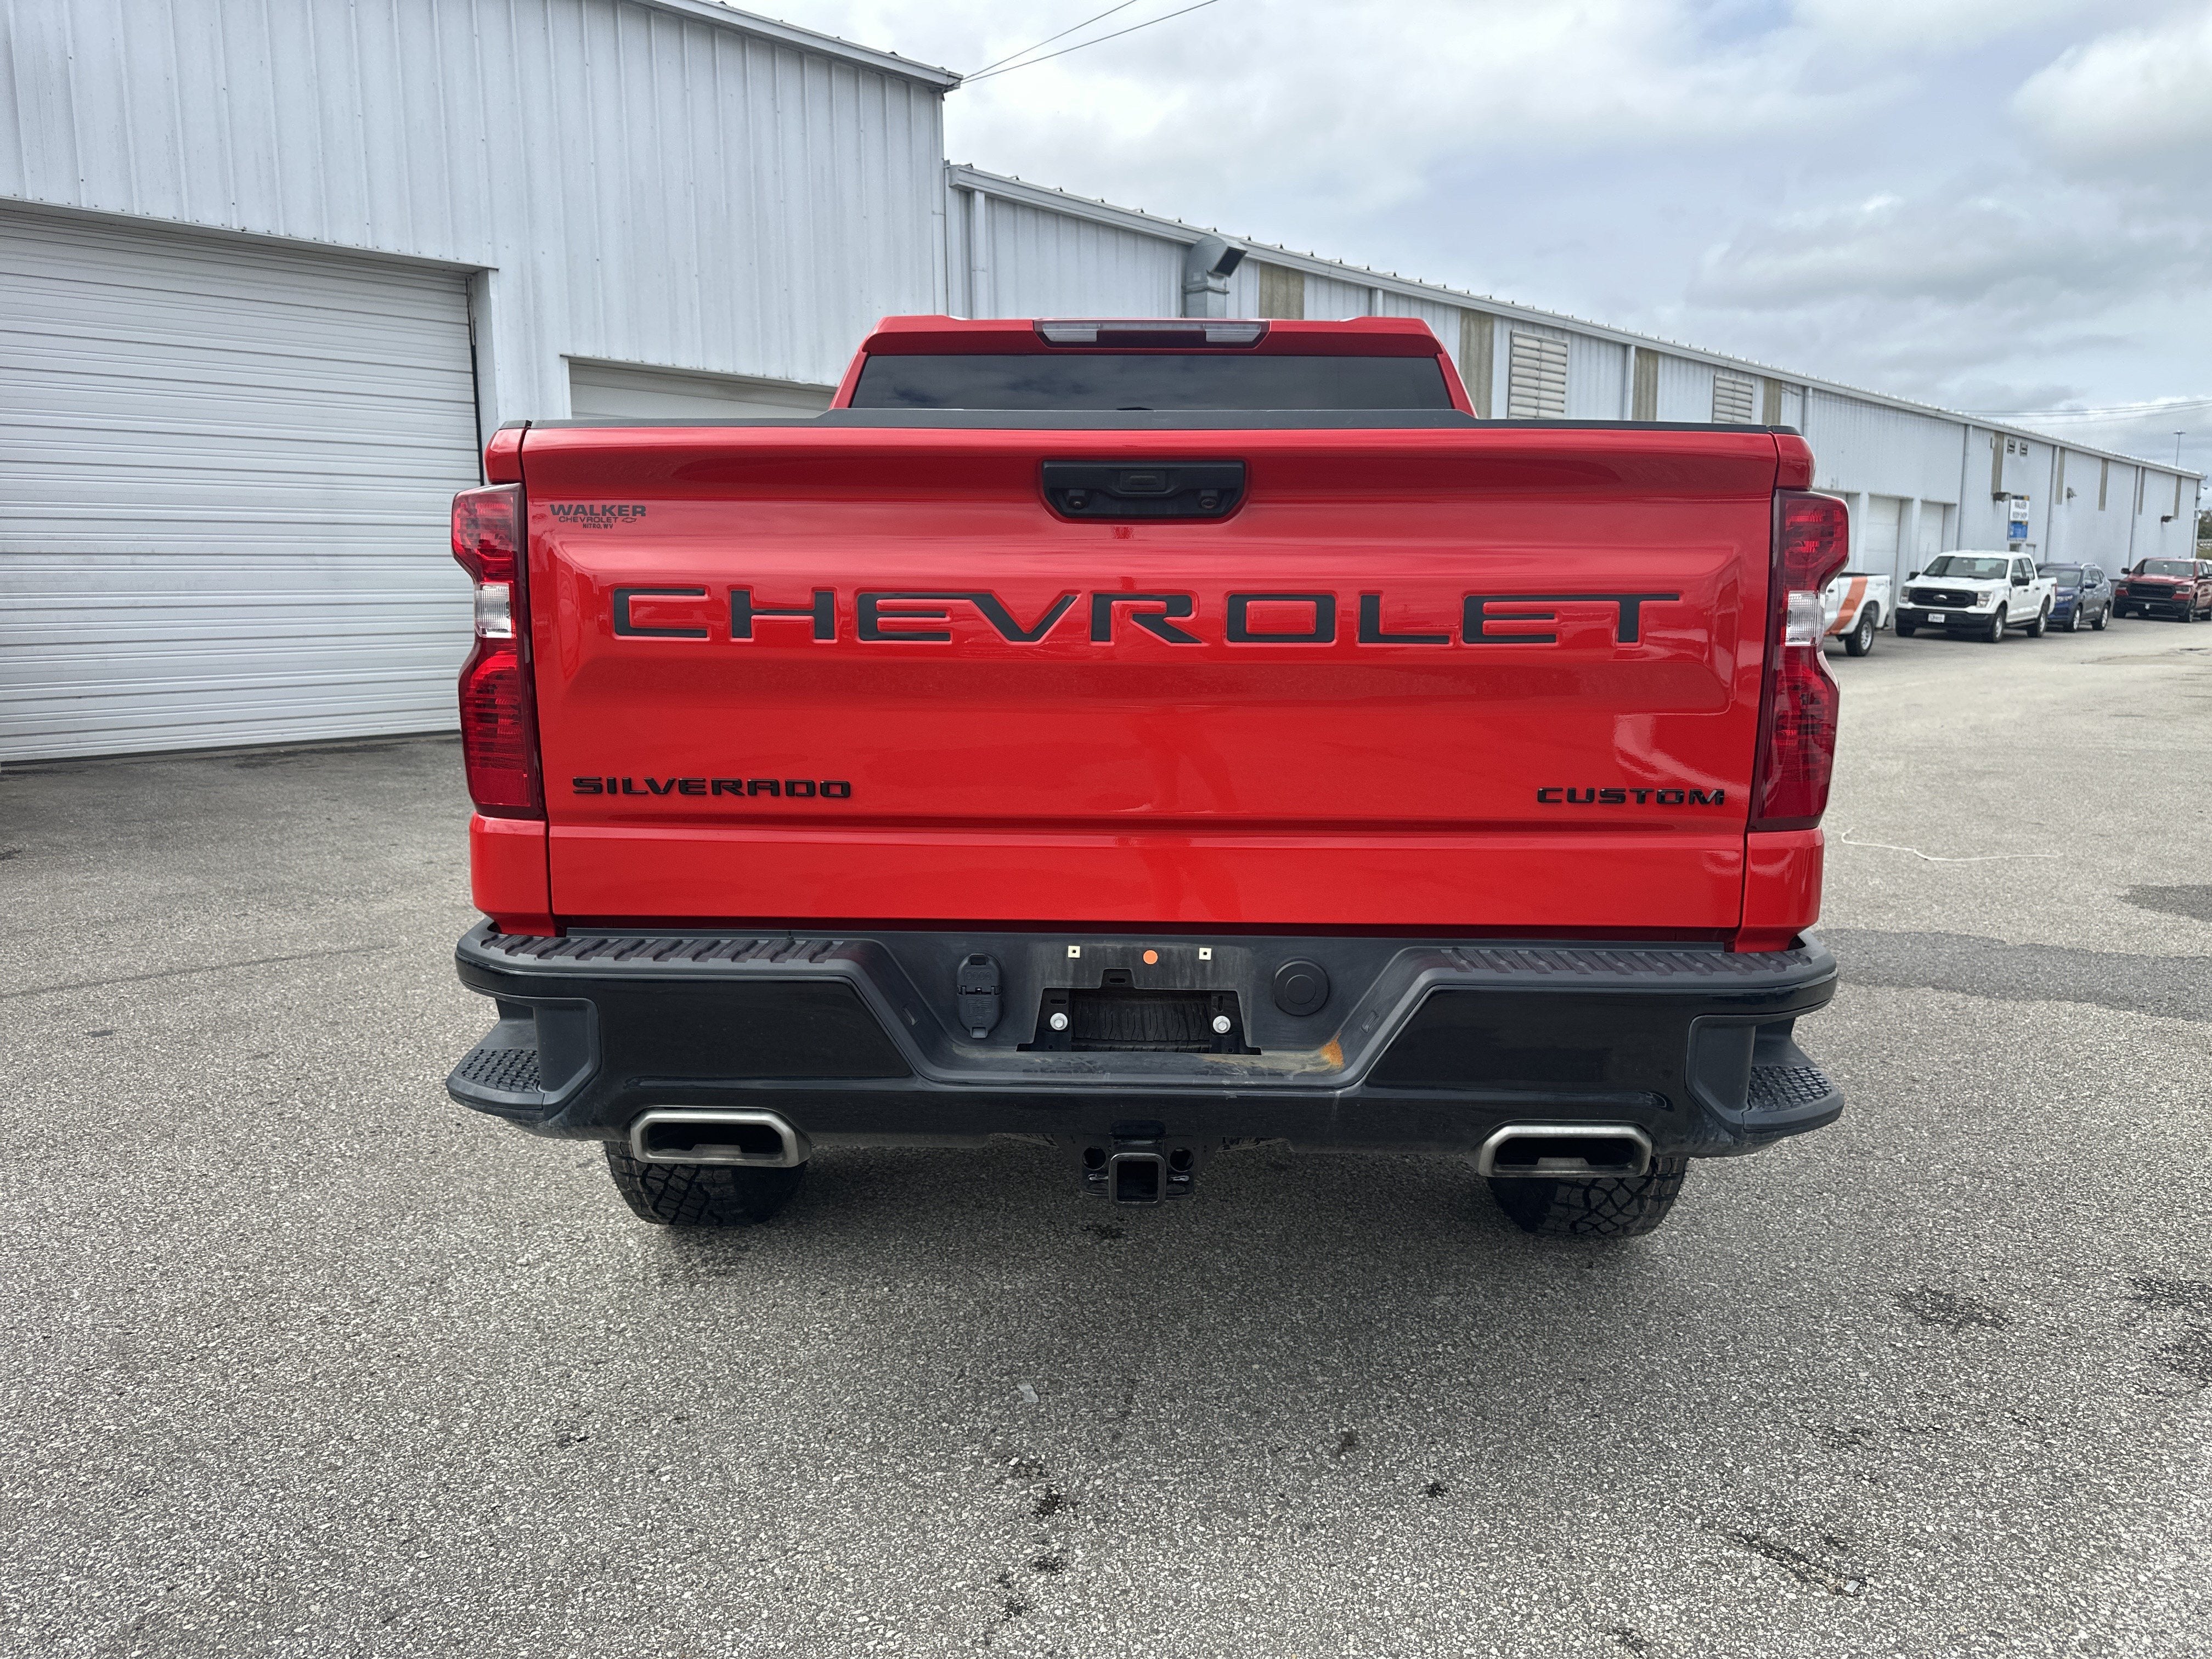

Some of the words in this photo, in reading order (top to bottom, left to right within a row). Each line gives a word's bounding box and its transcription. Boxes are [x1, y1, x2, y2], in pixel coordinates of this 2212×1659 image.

[550, 504, 646, 517] WALKER
[613, 588, 1681, 645] CHEVROLET
[572, 776, 851, 798] SILVERADO
[1537, 787, 1725, 805] CUSTOM
